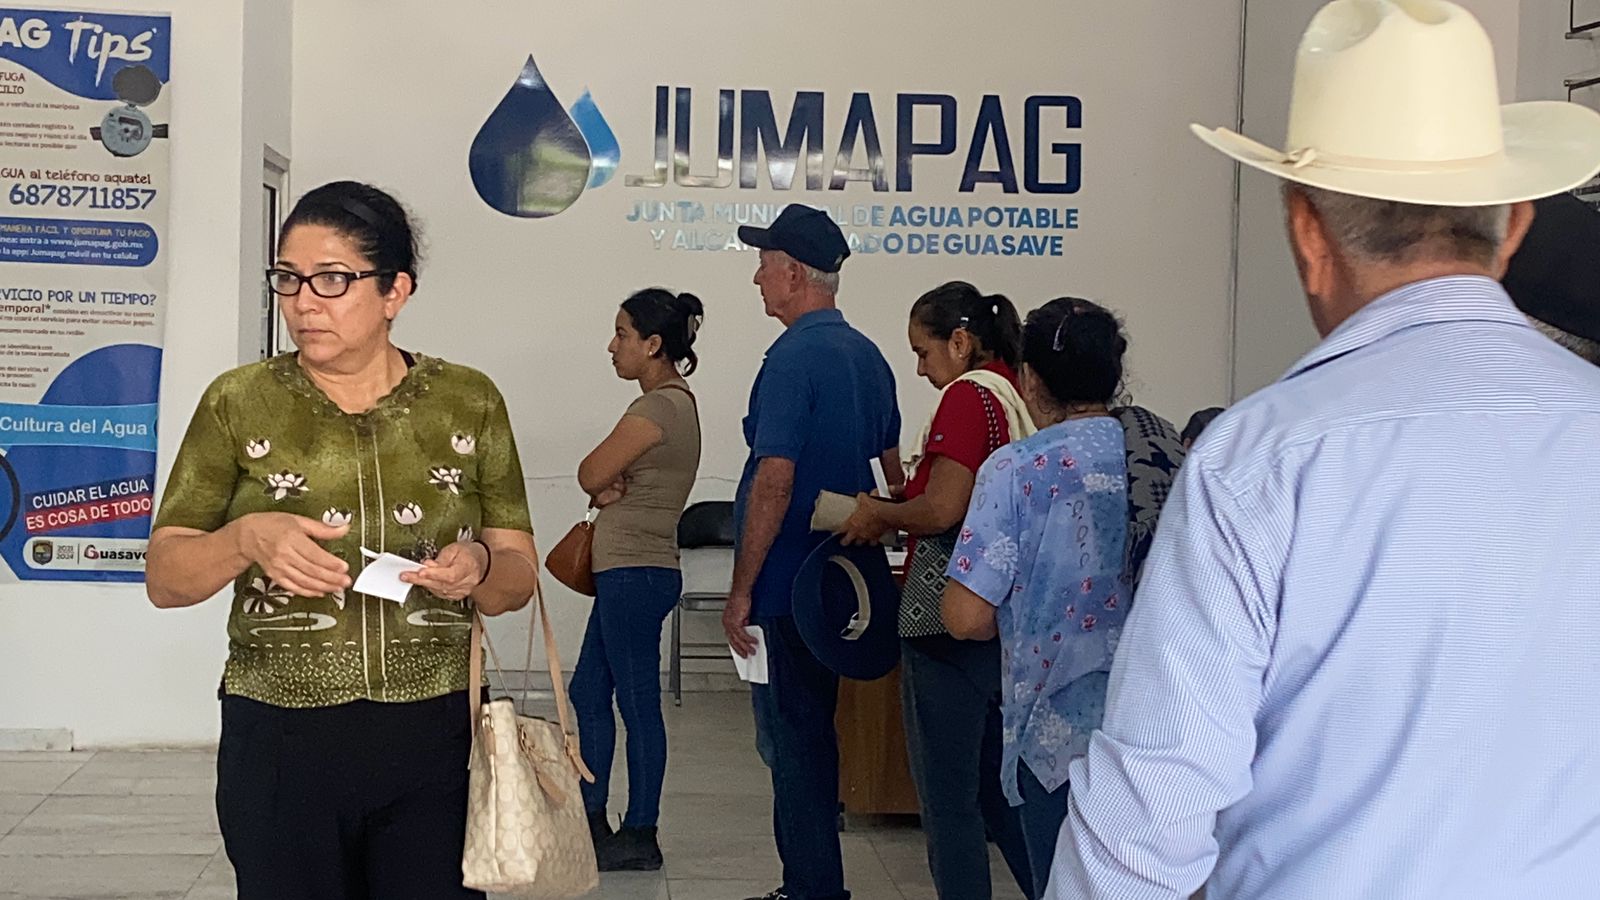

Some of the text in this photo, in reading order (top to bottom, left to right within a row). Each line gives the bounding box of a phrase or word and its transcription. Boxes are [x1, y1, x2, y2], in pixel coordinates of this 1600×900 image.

[0, 15, 154, 88] AG Tips
[624, 86, 1082, 194] JUMAPAG
[0, 168, 151, 186] GUA al teléfono aquatel
[9, 183, 157, 211] 6878711857
[626, 200, 704, 223] JUNTA
[853, 206, 885, 228] DE
[888, 206, 964, 228] AGUA
[967, 206, 1079, 229] POTABLE
[650, 229, 665, 250] Y
[907, 233, 939, 254] DE
[943, 233, 1064, 256] GUASAVE
[0, 288, 157, 306] VICIO POR UN TIEMPO?
[0, 416, 148, 438] Cultura del Agua
[32, 478, 150, 509] CUIDAR EL AGUA
[26, 497, 152, 530] ES COSA DE TODO
